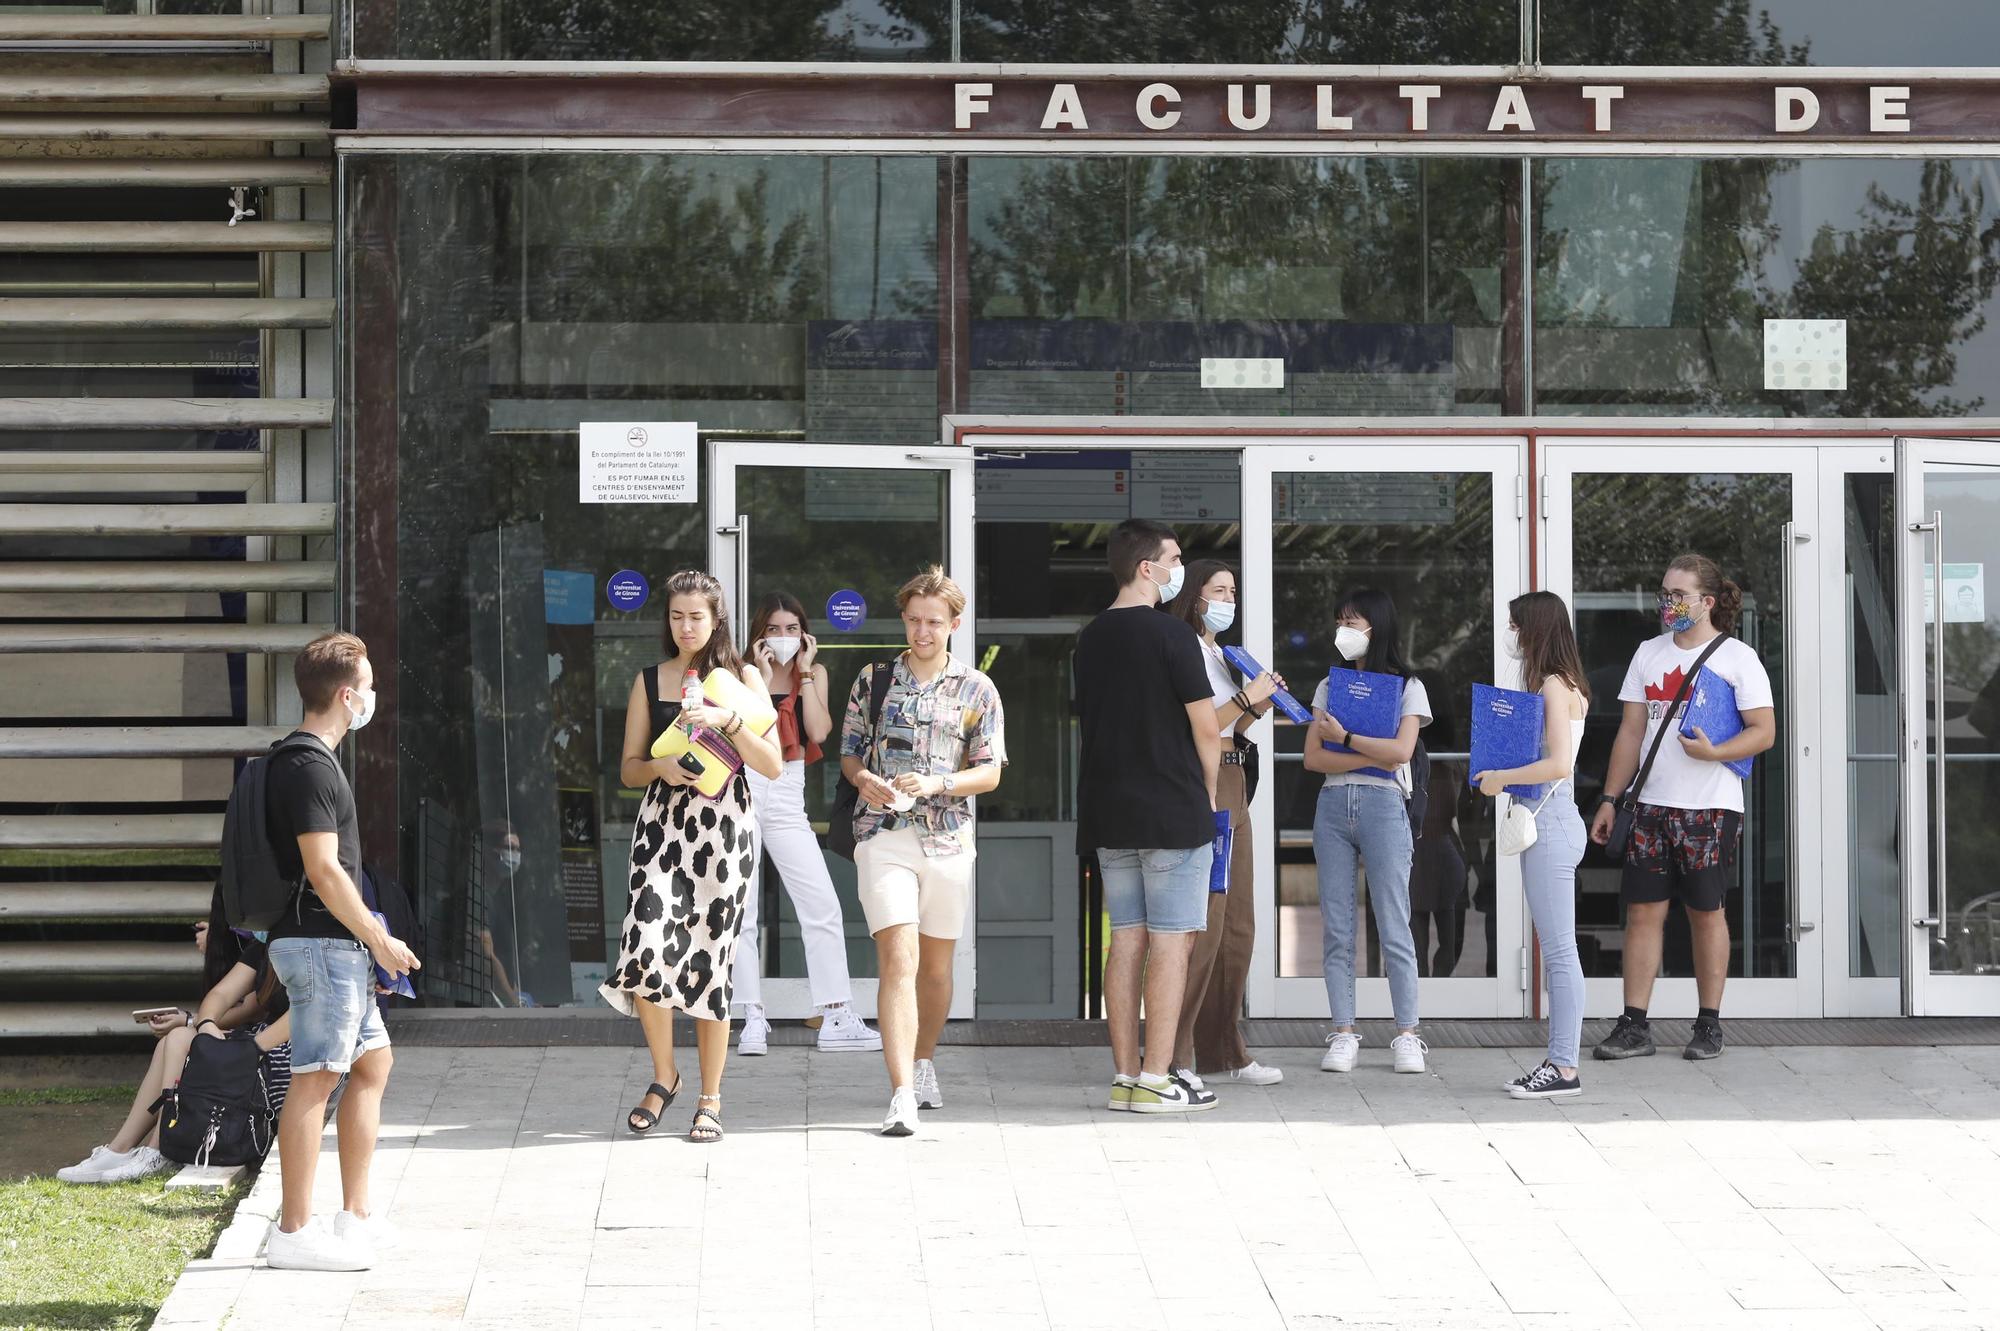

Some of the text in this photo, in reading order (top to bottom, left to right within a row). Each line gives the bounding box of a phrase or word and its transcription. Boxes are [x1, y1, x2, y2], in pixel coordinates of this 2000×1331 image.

[954, 83, 1911, 132] FACULTAT DE
[601, 451, 636, 459] compliment
[597, 461, 607, 469] del
[608, 461, 638, 469] Parlament
[639, 461, 647, 469] de
